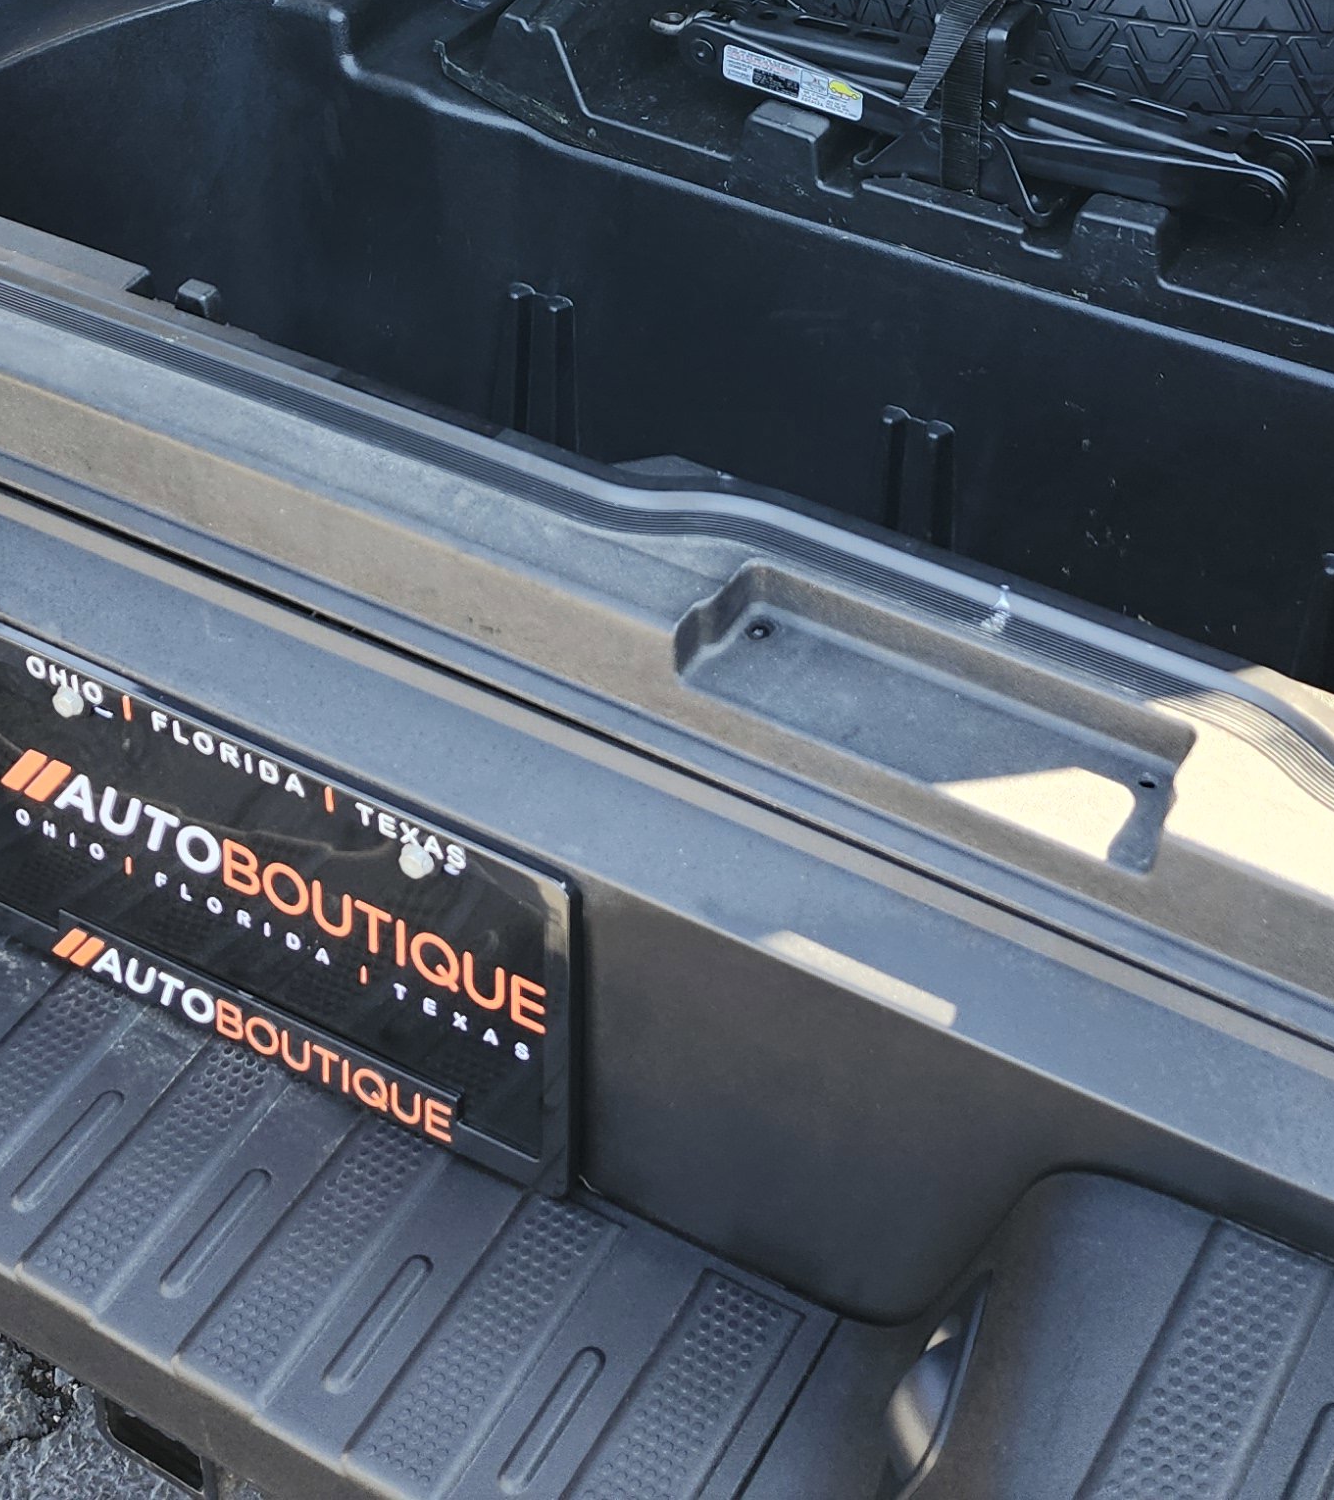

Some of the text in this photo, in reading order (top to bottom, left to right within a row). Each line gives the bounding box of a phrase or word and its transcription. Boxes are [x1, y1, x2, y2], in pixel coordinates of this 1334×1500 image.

[25, 655, 104, 705] OHIO
[151, 710, 306, 798] FLORIDA
[354, 801, 467, 870] TEXAS
[14, 807, 105, 861] OHIO
[154, 871, 331, 966] FLORIDA
[393, 982, 531, 1062] TEXAS
